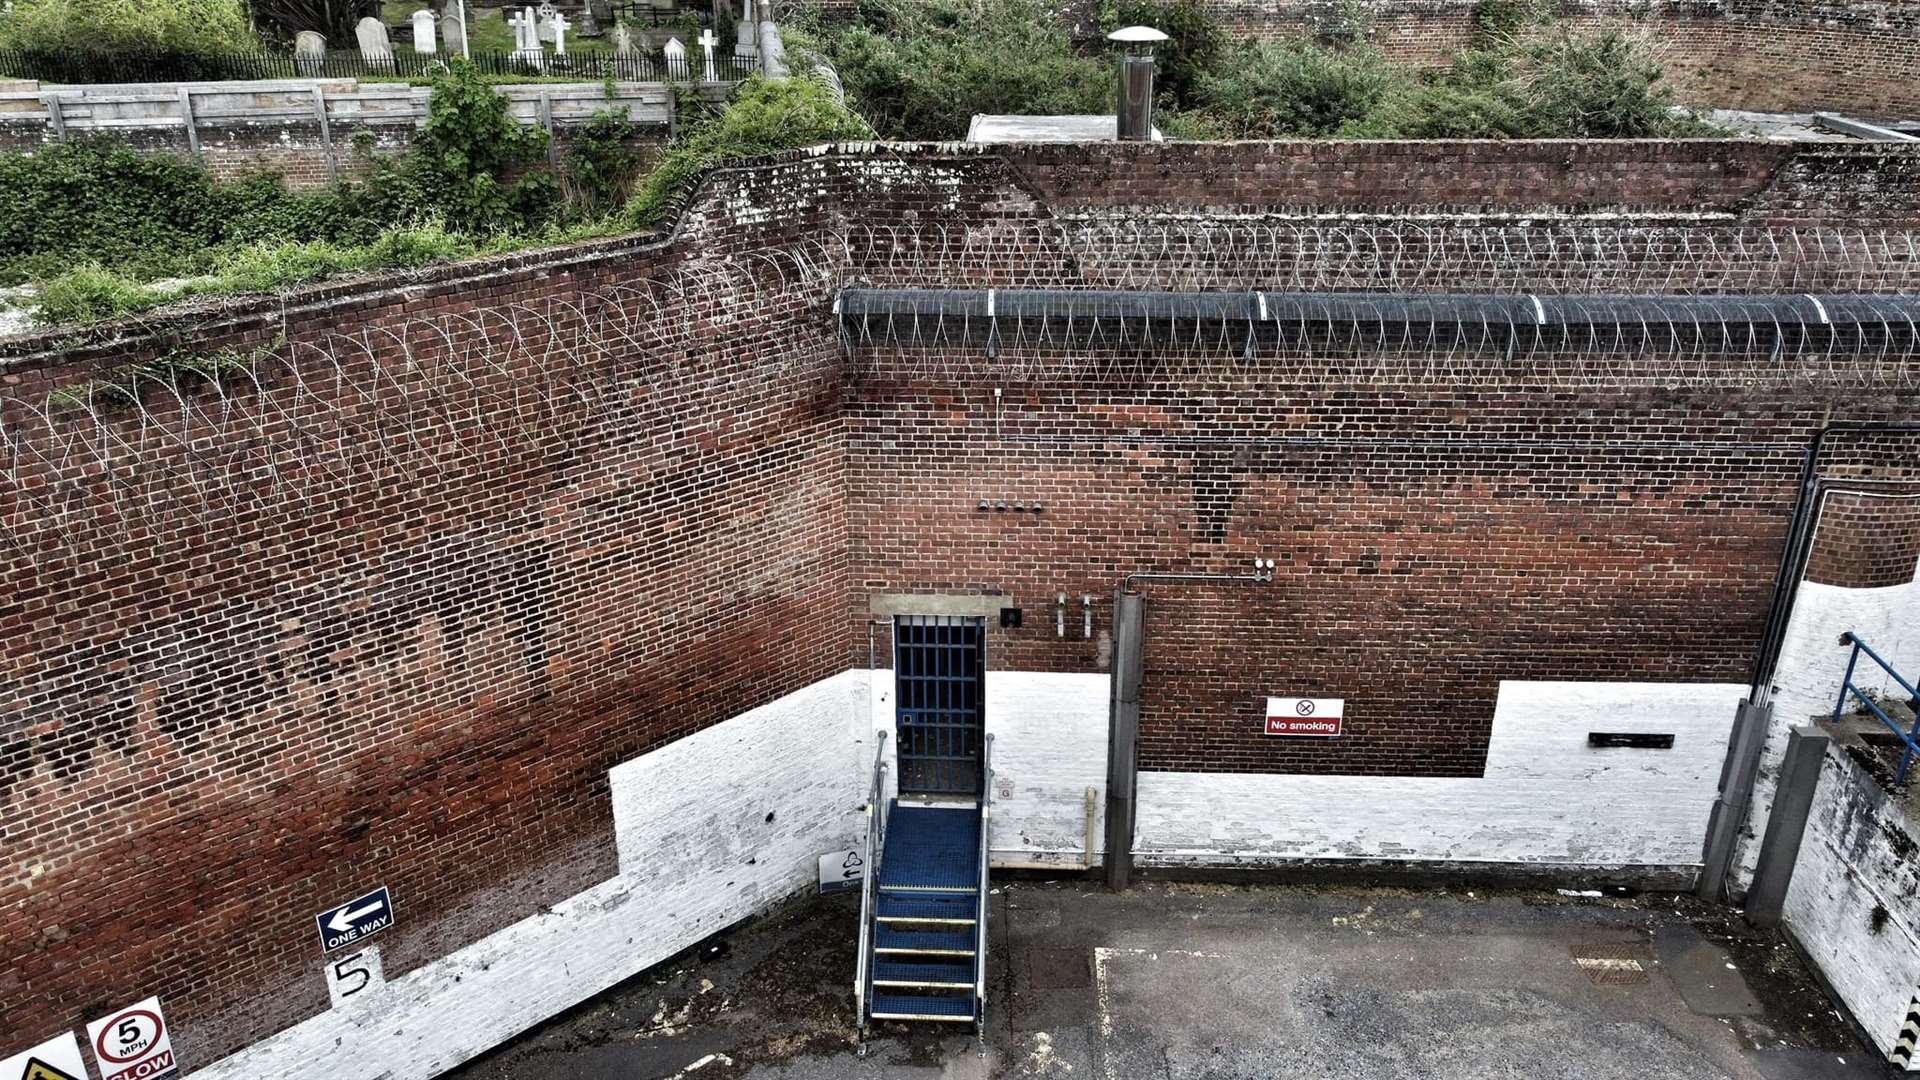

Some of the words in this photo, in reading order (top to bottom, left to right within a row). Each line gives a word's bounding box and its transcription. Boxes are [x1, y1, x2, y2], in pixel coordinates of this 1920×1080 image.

[1271, 720, 1286, 730] No
[1289, 722, 1335, 731] smoking
[328, 929, 357, 947] ONE
[360, 915, 387, 934] WAY
[334, 953, 370, 997] 5
[119, 1018, 140, 1044] 5
[120, 1039, 147, 1056] MPH
